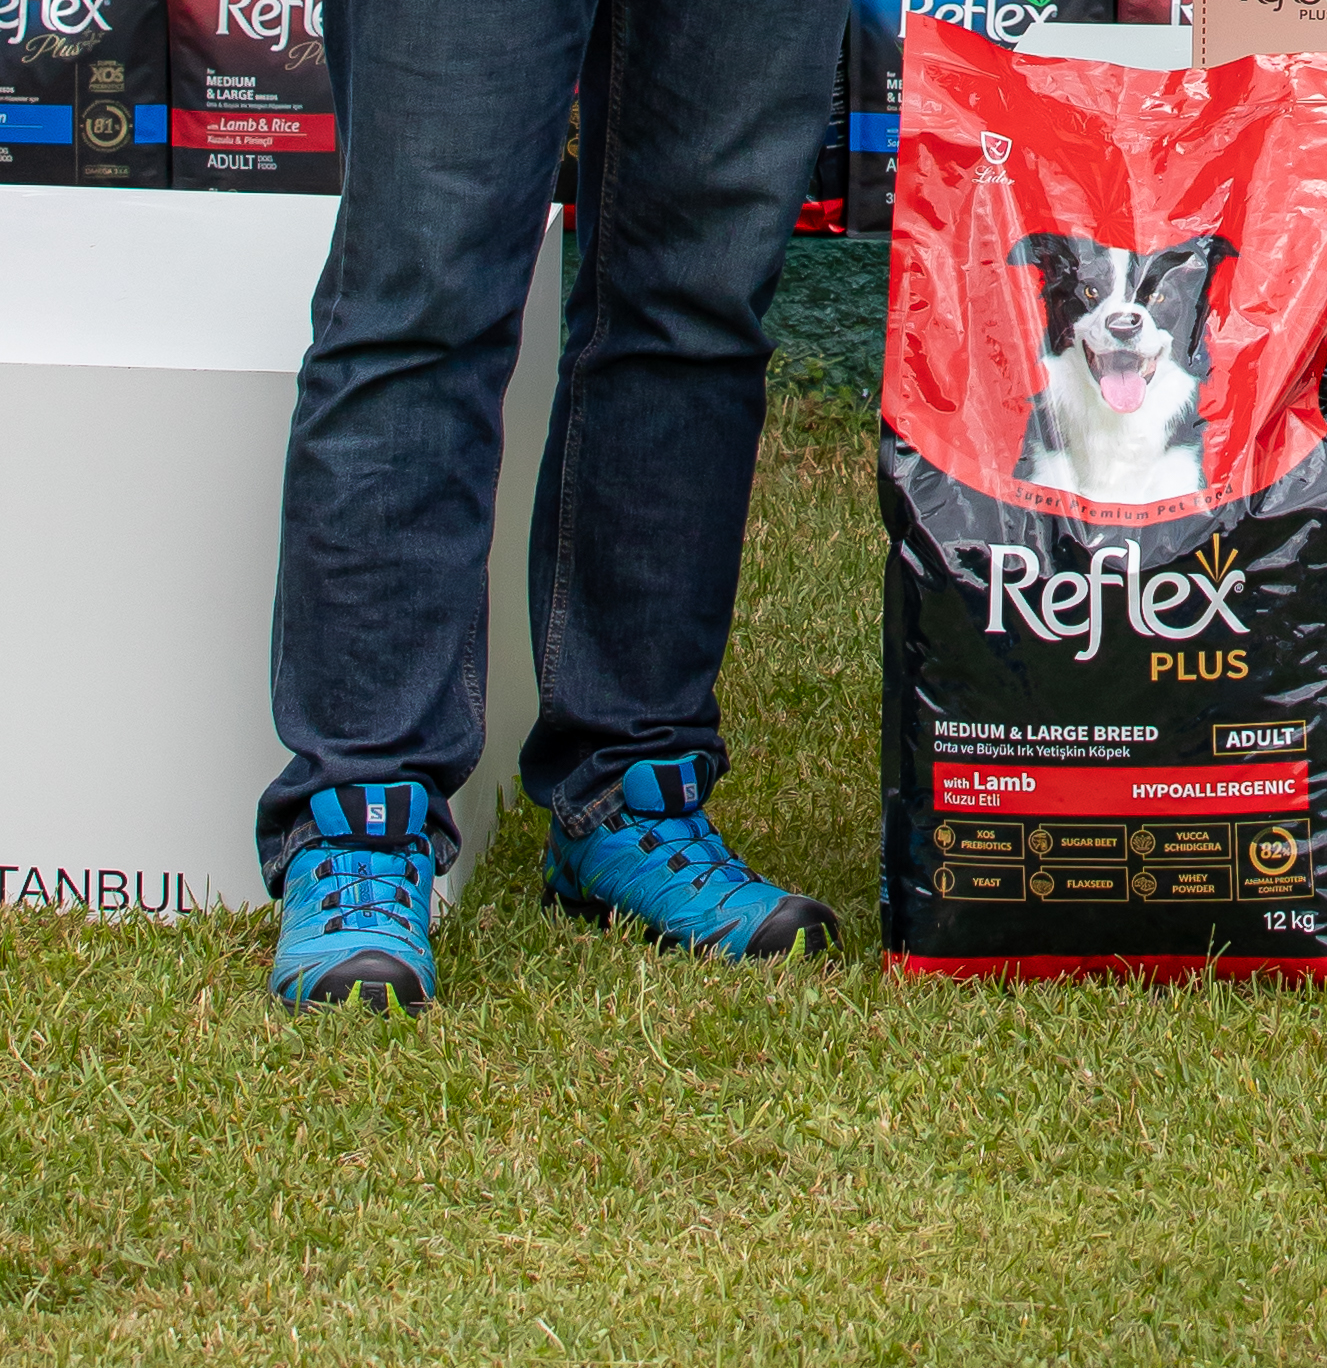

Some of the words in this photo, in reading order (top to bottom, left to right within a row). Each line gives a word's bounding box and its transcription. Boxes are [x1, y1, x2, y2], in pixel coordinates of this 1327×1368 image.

[21, 34, 81, 63] Plus
[206, 76, 256, 87] MEDIUM
[206, 89, 215, 100] &
[216, 90, 254, 101] LARGE
[220, 118, 257, 132] Lamb
[258, 118, 269, 131] &
[271, 118, 300, 133] Rice
[207, 154, 255, 170] ADULT
[971, 165, 1015, 185] Lider
[1015, 487, 1060, 507] Super
[1070, 500, 1149, 520] Premium
[1157, 503, 1184, 516] Pet
[984, 538, 1250, 661] Reflex
[1151, 650, 1249, 681] PLUS
[935, 721, 1005, 740] MEDIUM
[1009, 727, 1023, 741] &
[1027, 725, 1088, 742] LARGE
[1094, 725, 1159, 742] BREED
[1225, 727, 1295, 749] ADULT
[933, 741, 958, 754] Orta
[960, 746, 974, 755] ve
[976, 742, 1014, 759] Büyük
[1017, 745, 1033, 757] Irk
[1036, 745, 1086, 761] Yetişkin
[1089, 745, 1131, 761] Köpek
[944, 776, 970, 790] with
[973, 772, 1036, 792] Lamb
[1132, 779, 1296, 799] HYPOALLERGENIC
[944, 792, 975, 806] Kuzu
[979, 793, 1000, 807] Etli
[977, 830, 995, 839] XOS
[1176, 831, 1210, 842] YUCCA
[961, 840, 1013, 852] PREBIOTICS
[1061, 837, 1092, 848] SUGAR
[1095, 837, 1118, 848] BEET
[1164, 841, 1222, 853] SCHIDIGERA
[1260, 840, 1292, 860] 82%
[972, 877, 1001, 887] YEAST
[1067, 879, 1114, 890] FLAXSEED
[1178, 873, 1208, 884] WHEY
[1172, 883, 1216, 895] POWDER
[1258, 885, 1293, 895] CONTENT
[1263, 911, 1287, 932] 12
[1291, 910, 1316, 934] kg
